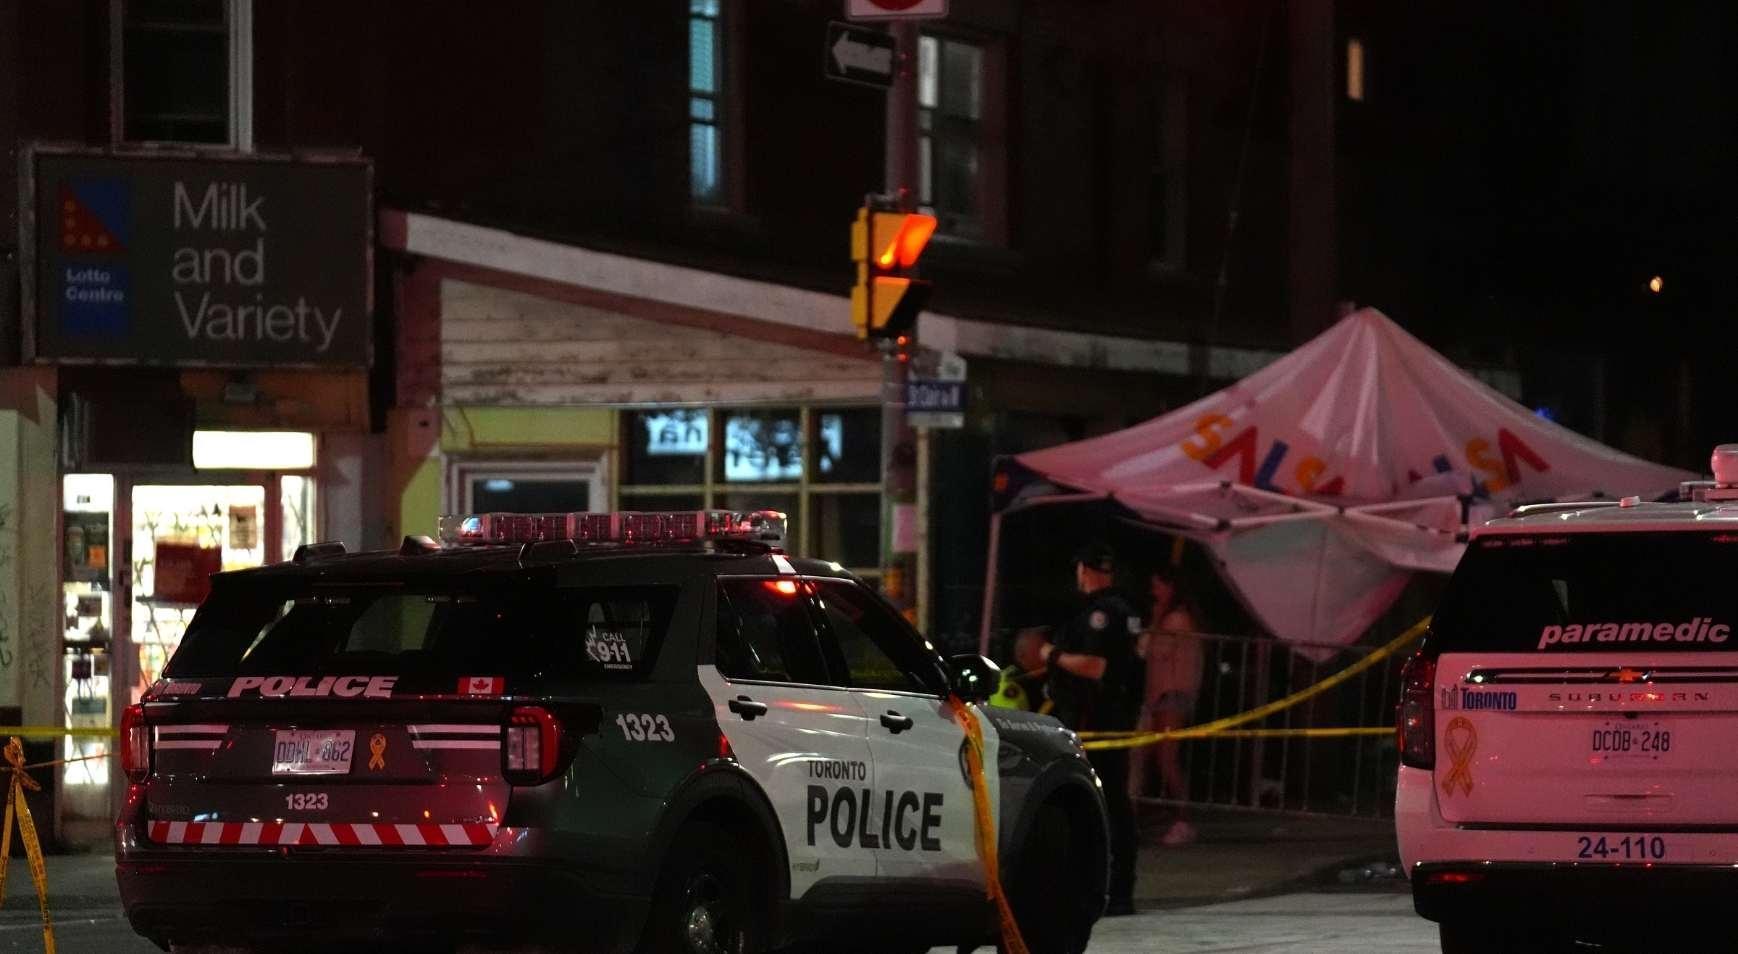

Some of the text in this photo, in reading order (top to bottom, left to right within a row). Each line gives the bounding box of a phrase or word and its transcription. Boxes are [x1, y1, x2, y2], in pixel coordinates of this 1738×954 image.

[173, 181, 267, 231] Milk
[172, 237, 265, 285] and
[65, 267, 111, 283] Lotto
[65, 286, 125, 303] Centre
[174, 290, 343, 352] Variety
[602, 631, 626, 642] CALL
[1537, 617, 1731, 649] paramedic
[227, 675, 399, 699] POLICE
[1460, 687, 1517, 711] TORONTO
[615, 713, 676, 743] 1323
[1593, 730, 1672, 752] DCDB 248
[806, 760, 867, 781] TORONTO
[284, 792, 329, 811] 1323
[806, 784, 944, 851] POLICE
[1577, 836, 1666, 859] 24-110
